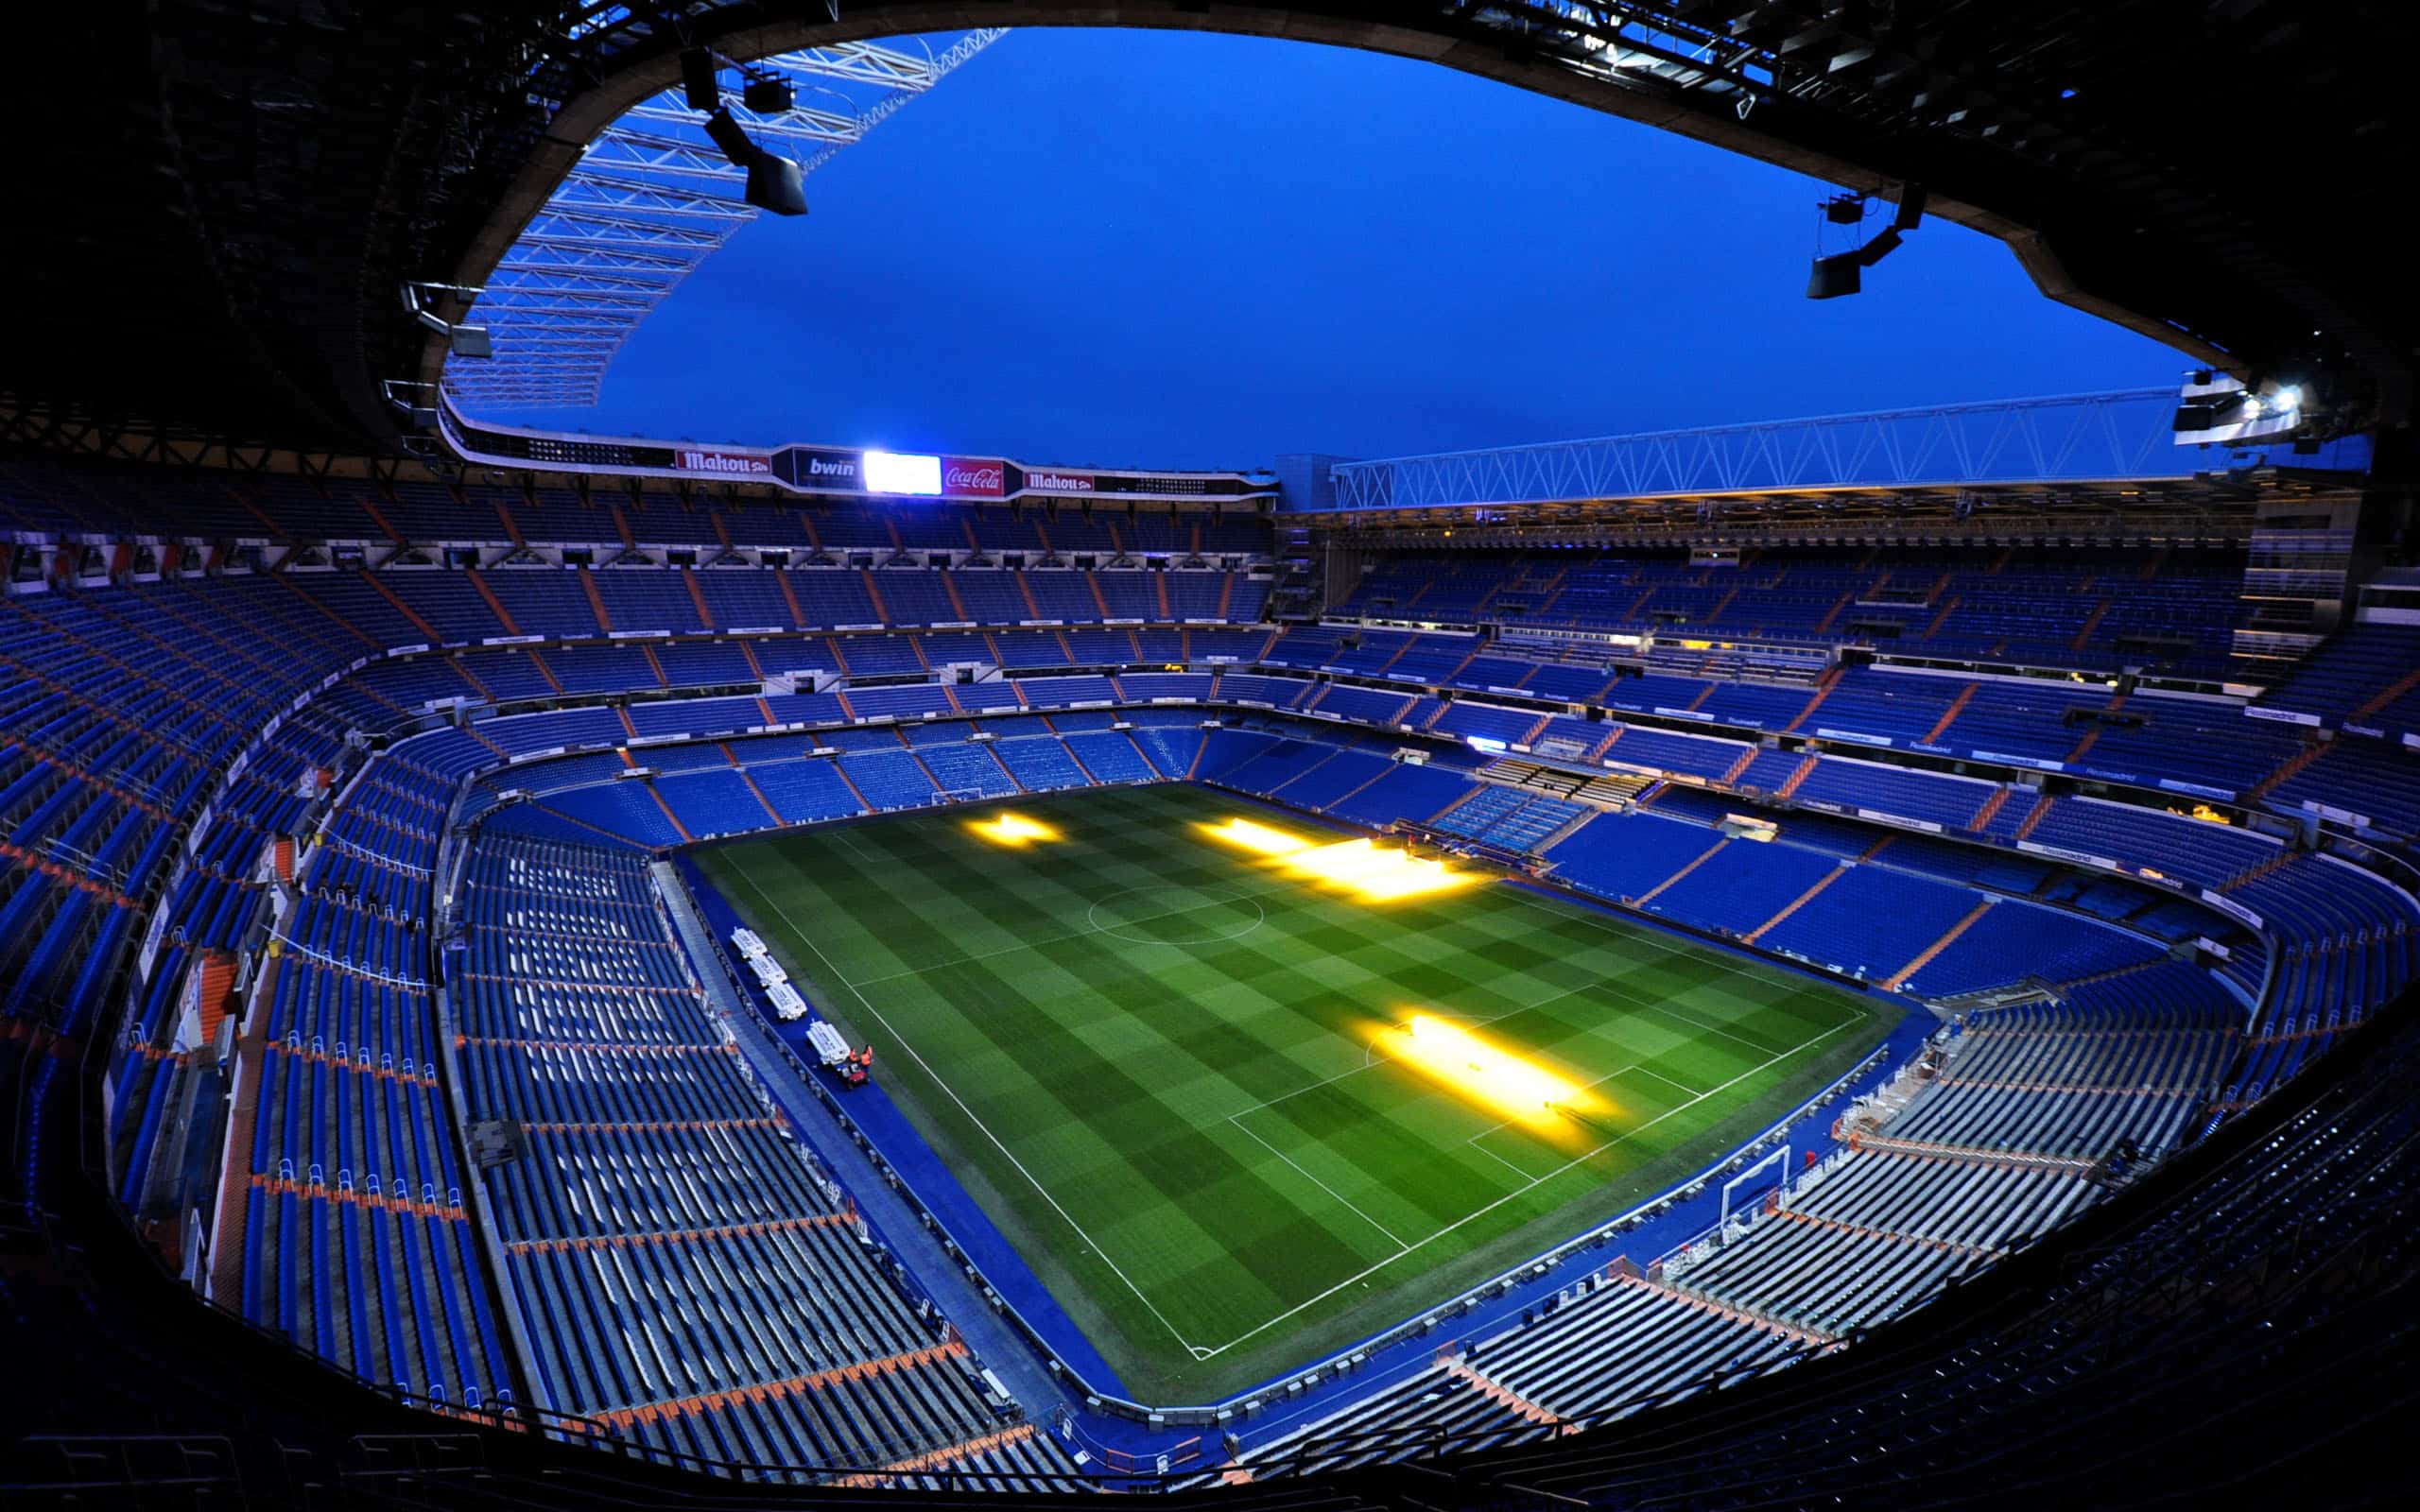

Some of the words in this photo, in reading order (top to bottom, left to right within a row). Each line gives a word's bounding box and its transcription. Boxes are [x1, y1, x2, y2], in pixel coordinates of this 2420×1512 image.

[685, 452, 750, 472] Mahou
[809, 458, 855, 475] bwin
[1029, 473, 1077, 490] Mahou
